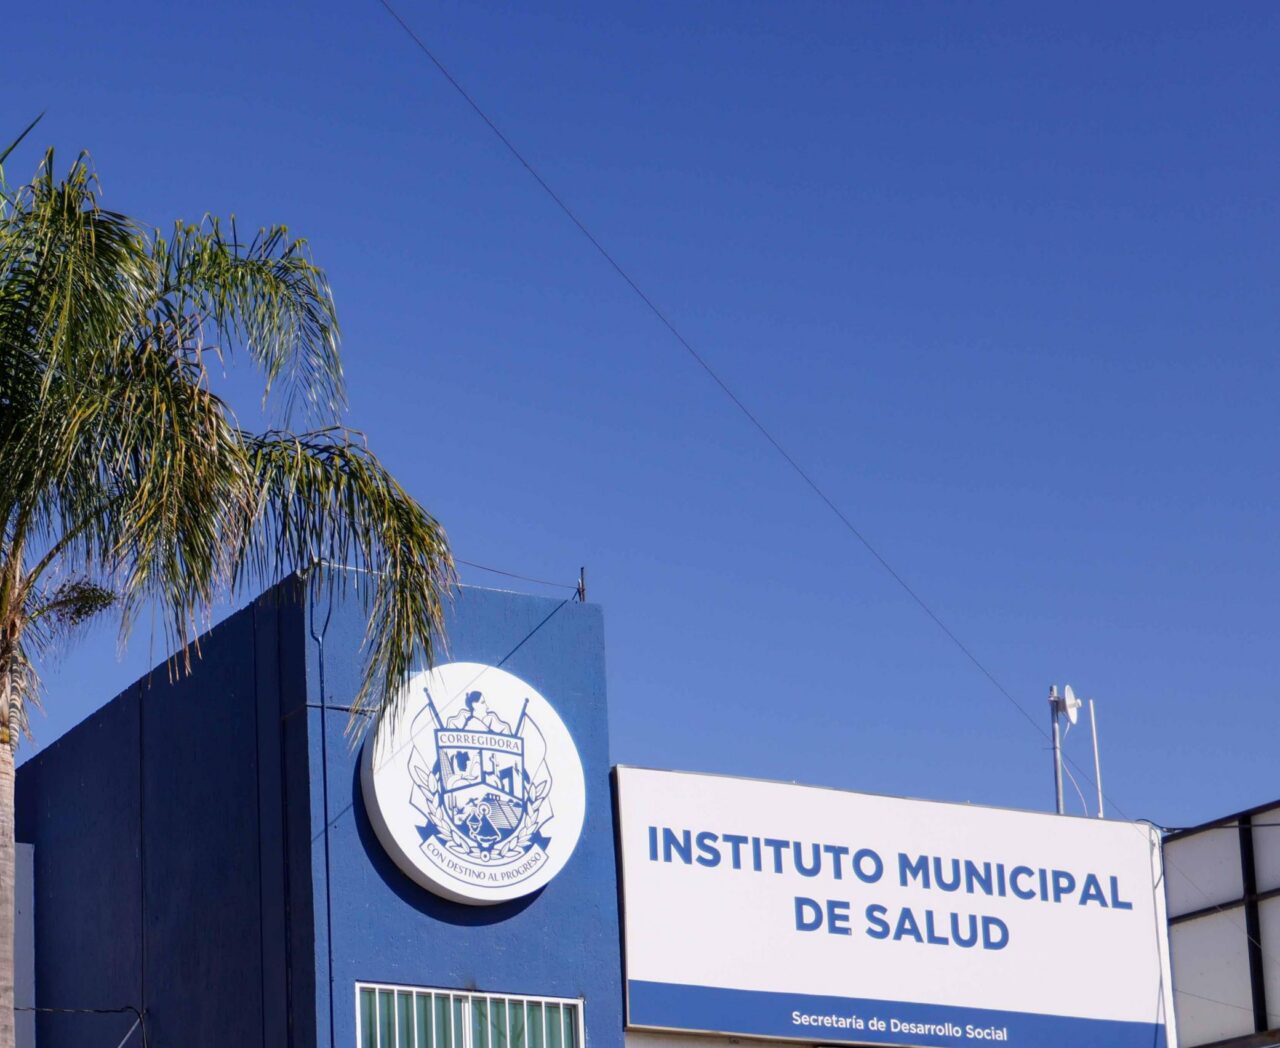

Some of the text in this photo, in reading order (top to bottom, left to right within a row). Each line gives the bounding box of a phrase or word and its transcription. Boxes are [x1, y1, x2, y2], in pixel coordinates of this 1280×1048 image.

[439, 733, 520, 751] CORREGIDORA
[426, 842, 542, 882] CON DESTINO AL PROGRESO
[648, 825, 1134, 911] INSTITUTO MUNICIPAL
[793, 895, 1010, 951] DE SALUD
[791, 1010, 1008, 1041] Secretaría de Desarrollo Social
